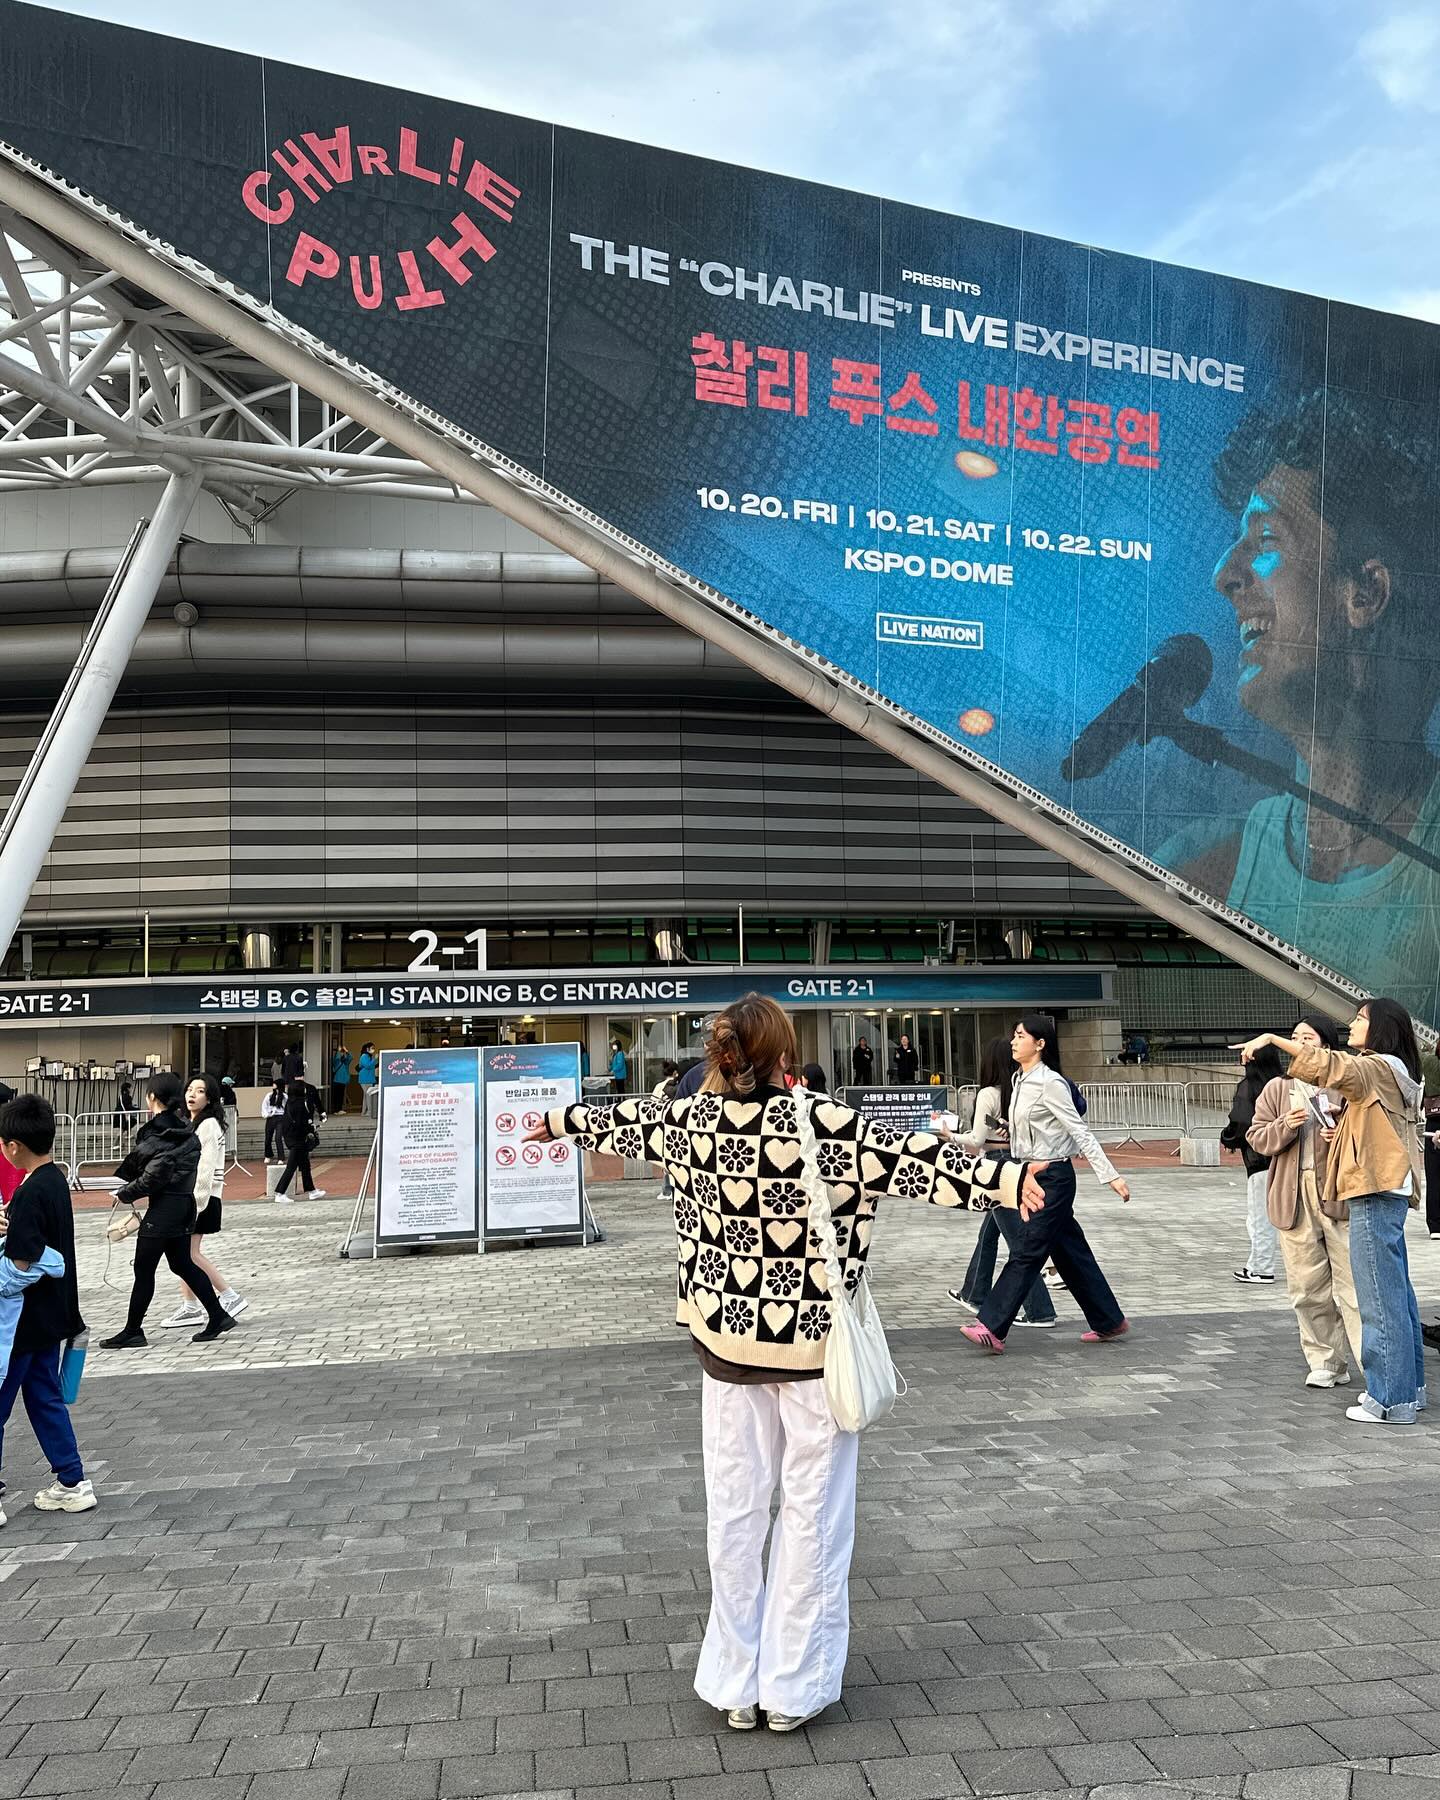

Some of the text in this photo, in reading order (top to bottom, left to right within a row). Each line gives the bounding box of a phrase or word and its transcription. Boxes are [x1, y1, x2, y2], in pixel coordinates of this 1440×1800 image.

[285, 211, 497, 312] PUTH
[902, 269, 982, 297] PRESENTS
[569, 232, 670, 286] THE
[920, 304, 1008, 349] LIVE
[1014, 321, 1246, 393] EXPERIENCE
[690, 331, 1161, 470] 찰리 푸스 내한공연
[793, 499, 838, 526] FRI
[944, 518, 996, 544] SAT
[1099, 540, 1152, 562] SUN
[844, 547, 1014, 587] KSPO DOME
[883, 620, 977, 643] LIVE NATION
[407, 928, 488, 973] 2-1
[0, 993, 90, 1015] GATE 2-1
[200, 990, 260, 1009] 스탠딩
[315, 987, 374, 1007] 출입구
[390, 985, 512, 1005] STANDING
[563, 981, 689, 1000] ENTRANCE
[787, 978, 875, 997] GATE 2-1
[505, 1088, 538, 1098] 반입금지
